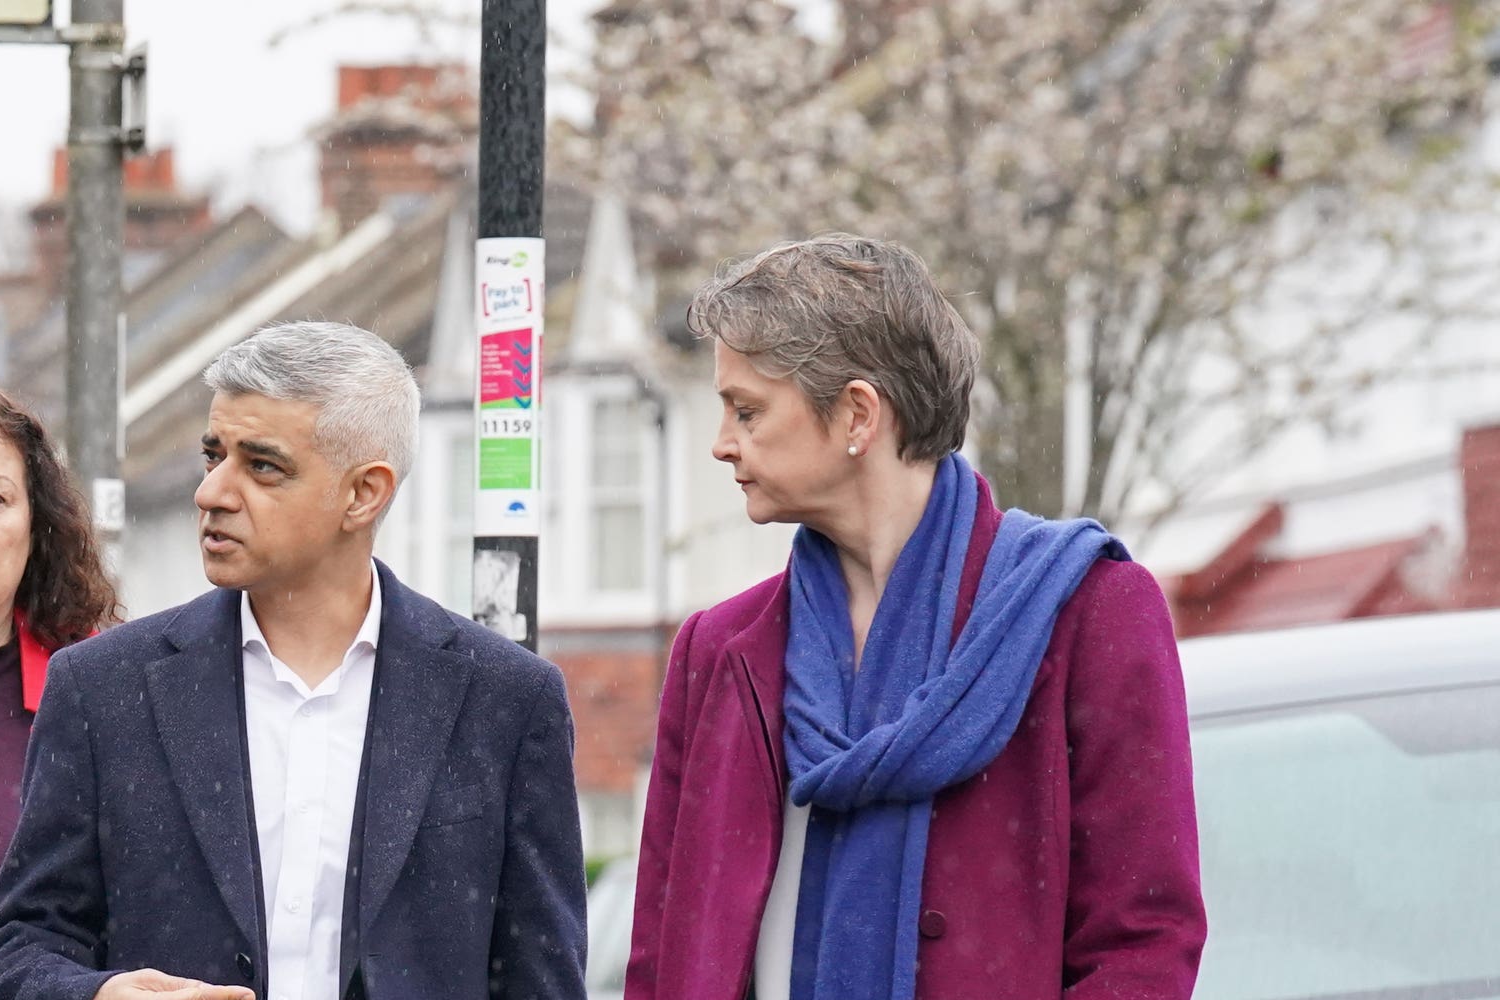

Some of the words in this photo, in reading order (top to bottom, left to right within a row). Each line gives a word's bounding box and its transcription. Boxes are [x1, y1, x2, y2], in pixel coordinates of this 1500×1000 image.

[488, 287, 507, 298] Pay
[510, 285, 525, 294] to
[483, 419, 532, 433] 11159
